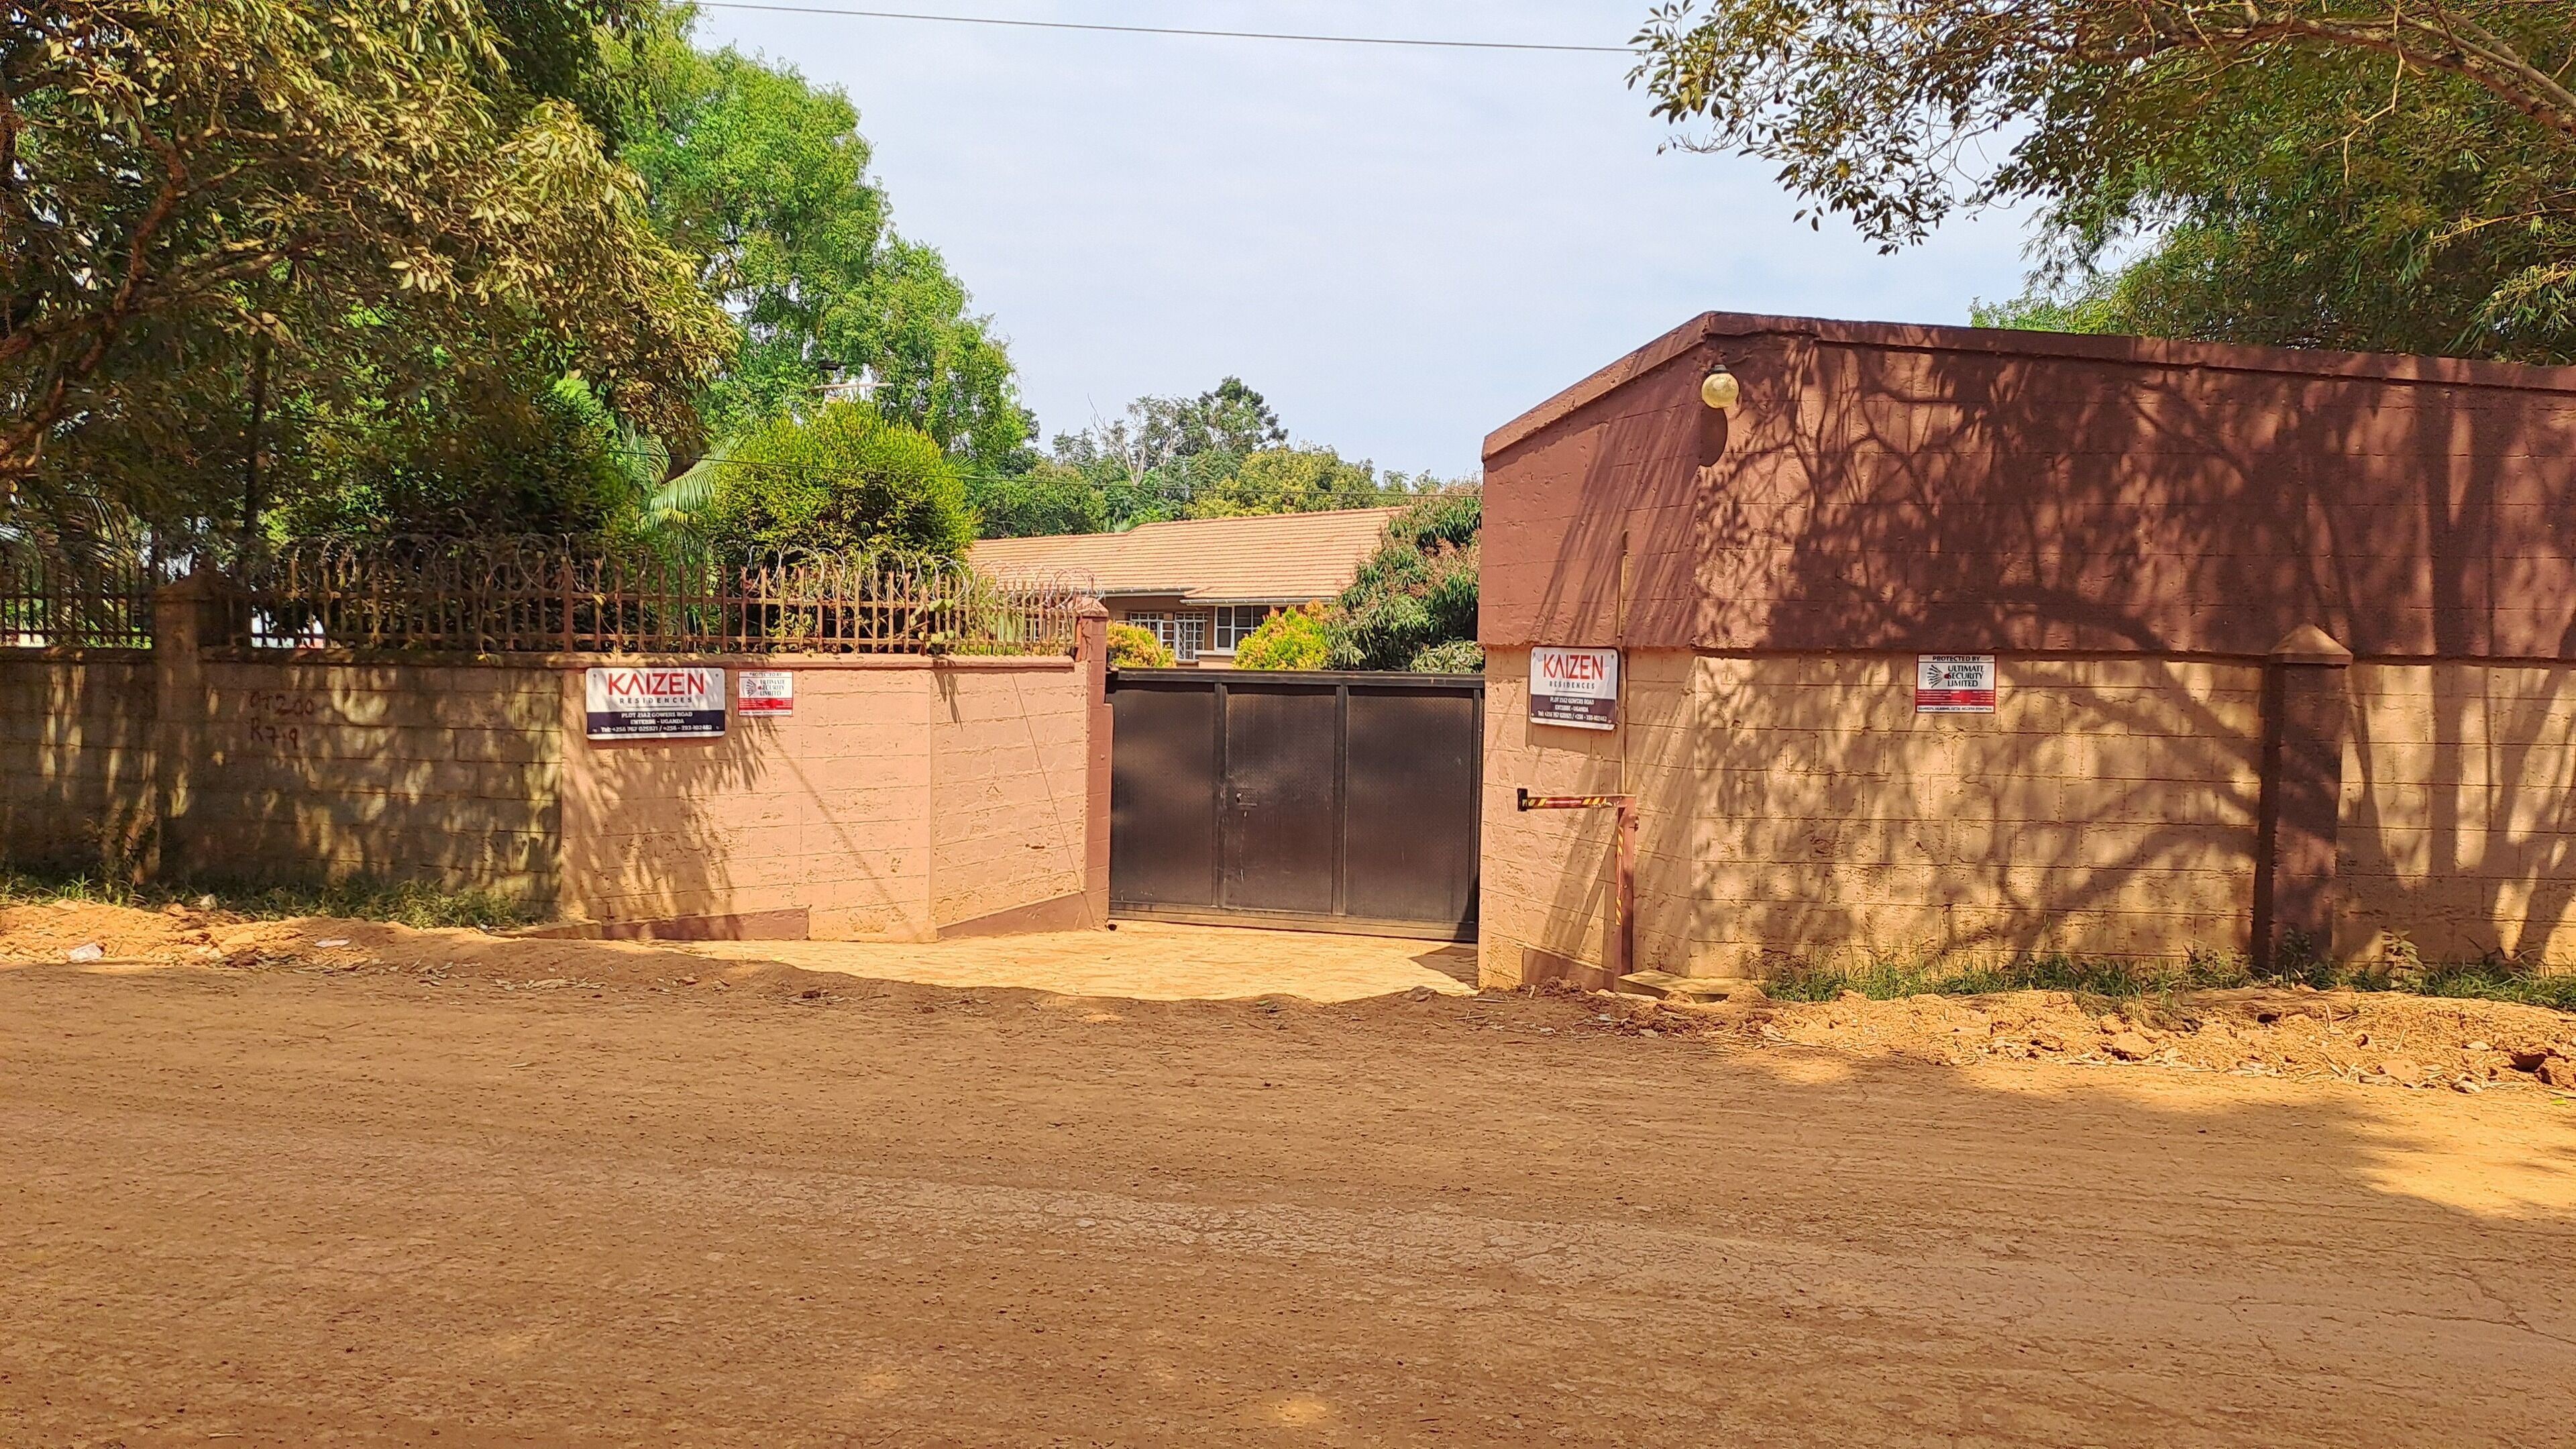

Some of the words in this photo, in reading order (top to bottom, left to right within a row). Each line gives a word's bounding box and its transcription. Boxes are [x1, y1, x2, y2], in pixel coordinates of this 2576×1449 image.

[1544, 653, 1603, 680] KAIZEN
[608, 672, 704, 696] KAIZEN
[1948, 672, 1983, 680] SECURITY
[1549, 681, 1595, 690] RESIDENCES
